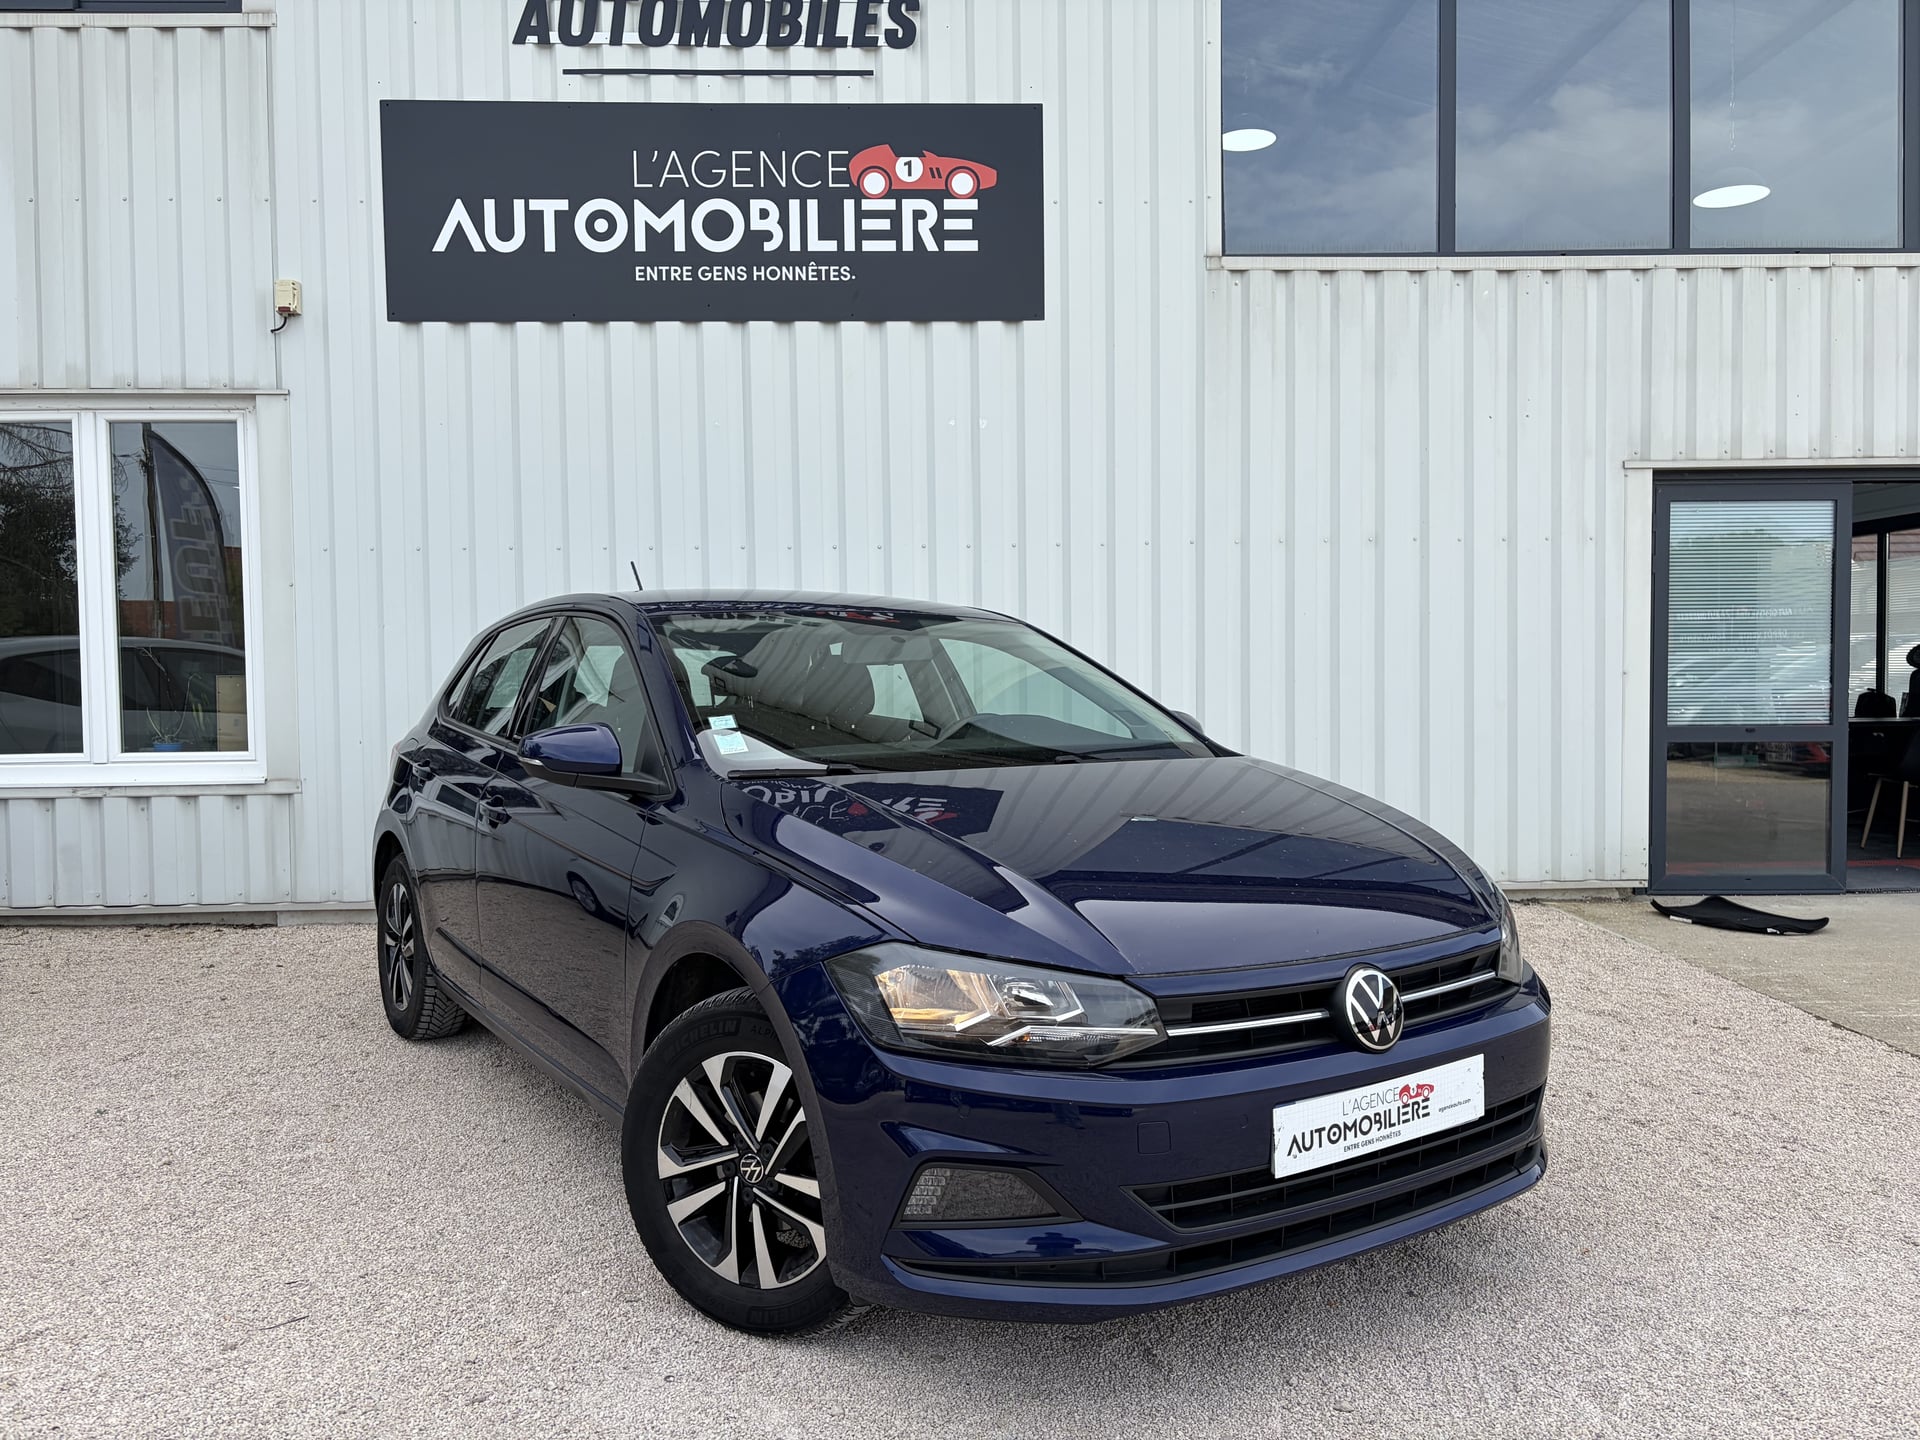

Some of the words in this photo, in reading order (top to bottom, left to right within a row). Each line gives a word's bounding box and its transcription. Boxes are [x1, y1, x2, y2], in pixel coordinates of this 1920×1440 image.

[513, 0, 919, 49] AUTOMOBILES
[632, 150, 849, 188] L'AGENCE
[902, 160, 912, 177] 1
[635, 265, 692, 282] ENTRE
[697, 265, 748, 282] GENS
[1342, 1086, 1400, 1116] L'AGENCE
[1343, 1142, 1360, 1153] ENTRE
[1360, 1139, 1375, 1148] GENS
